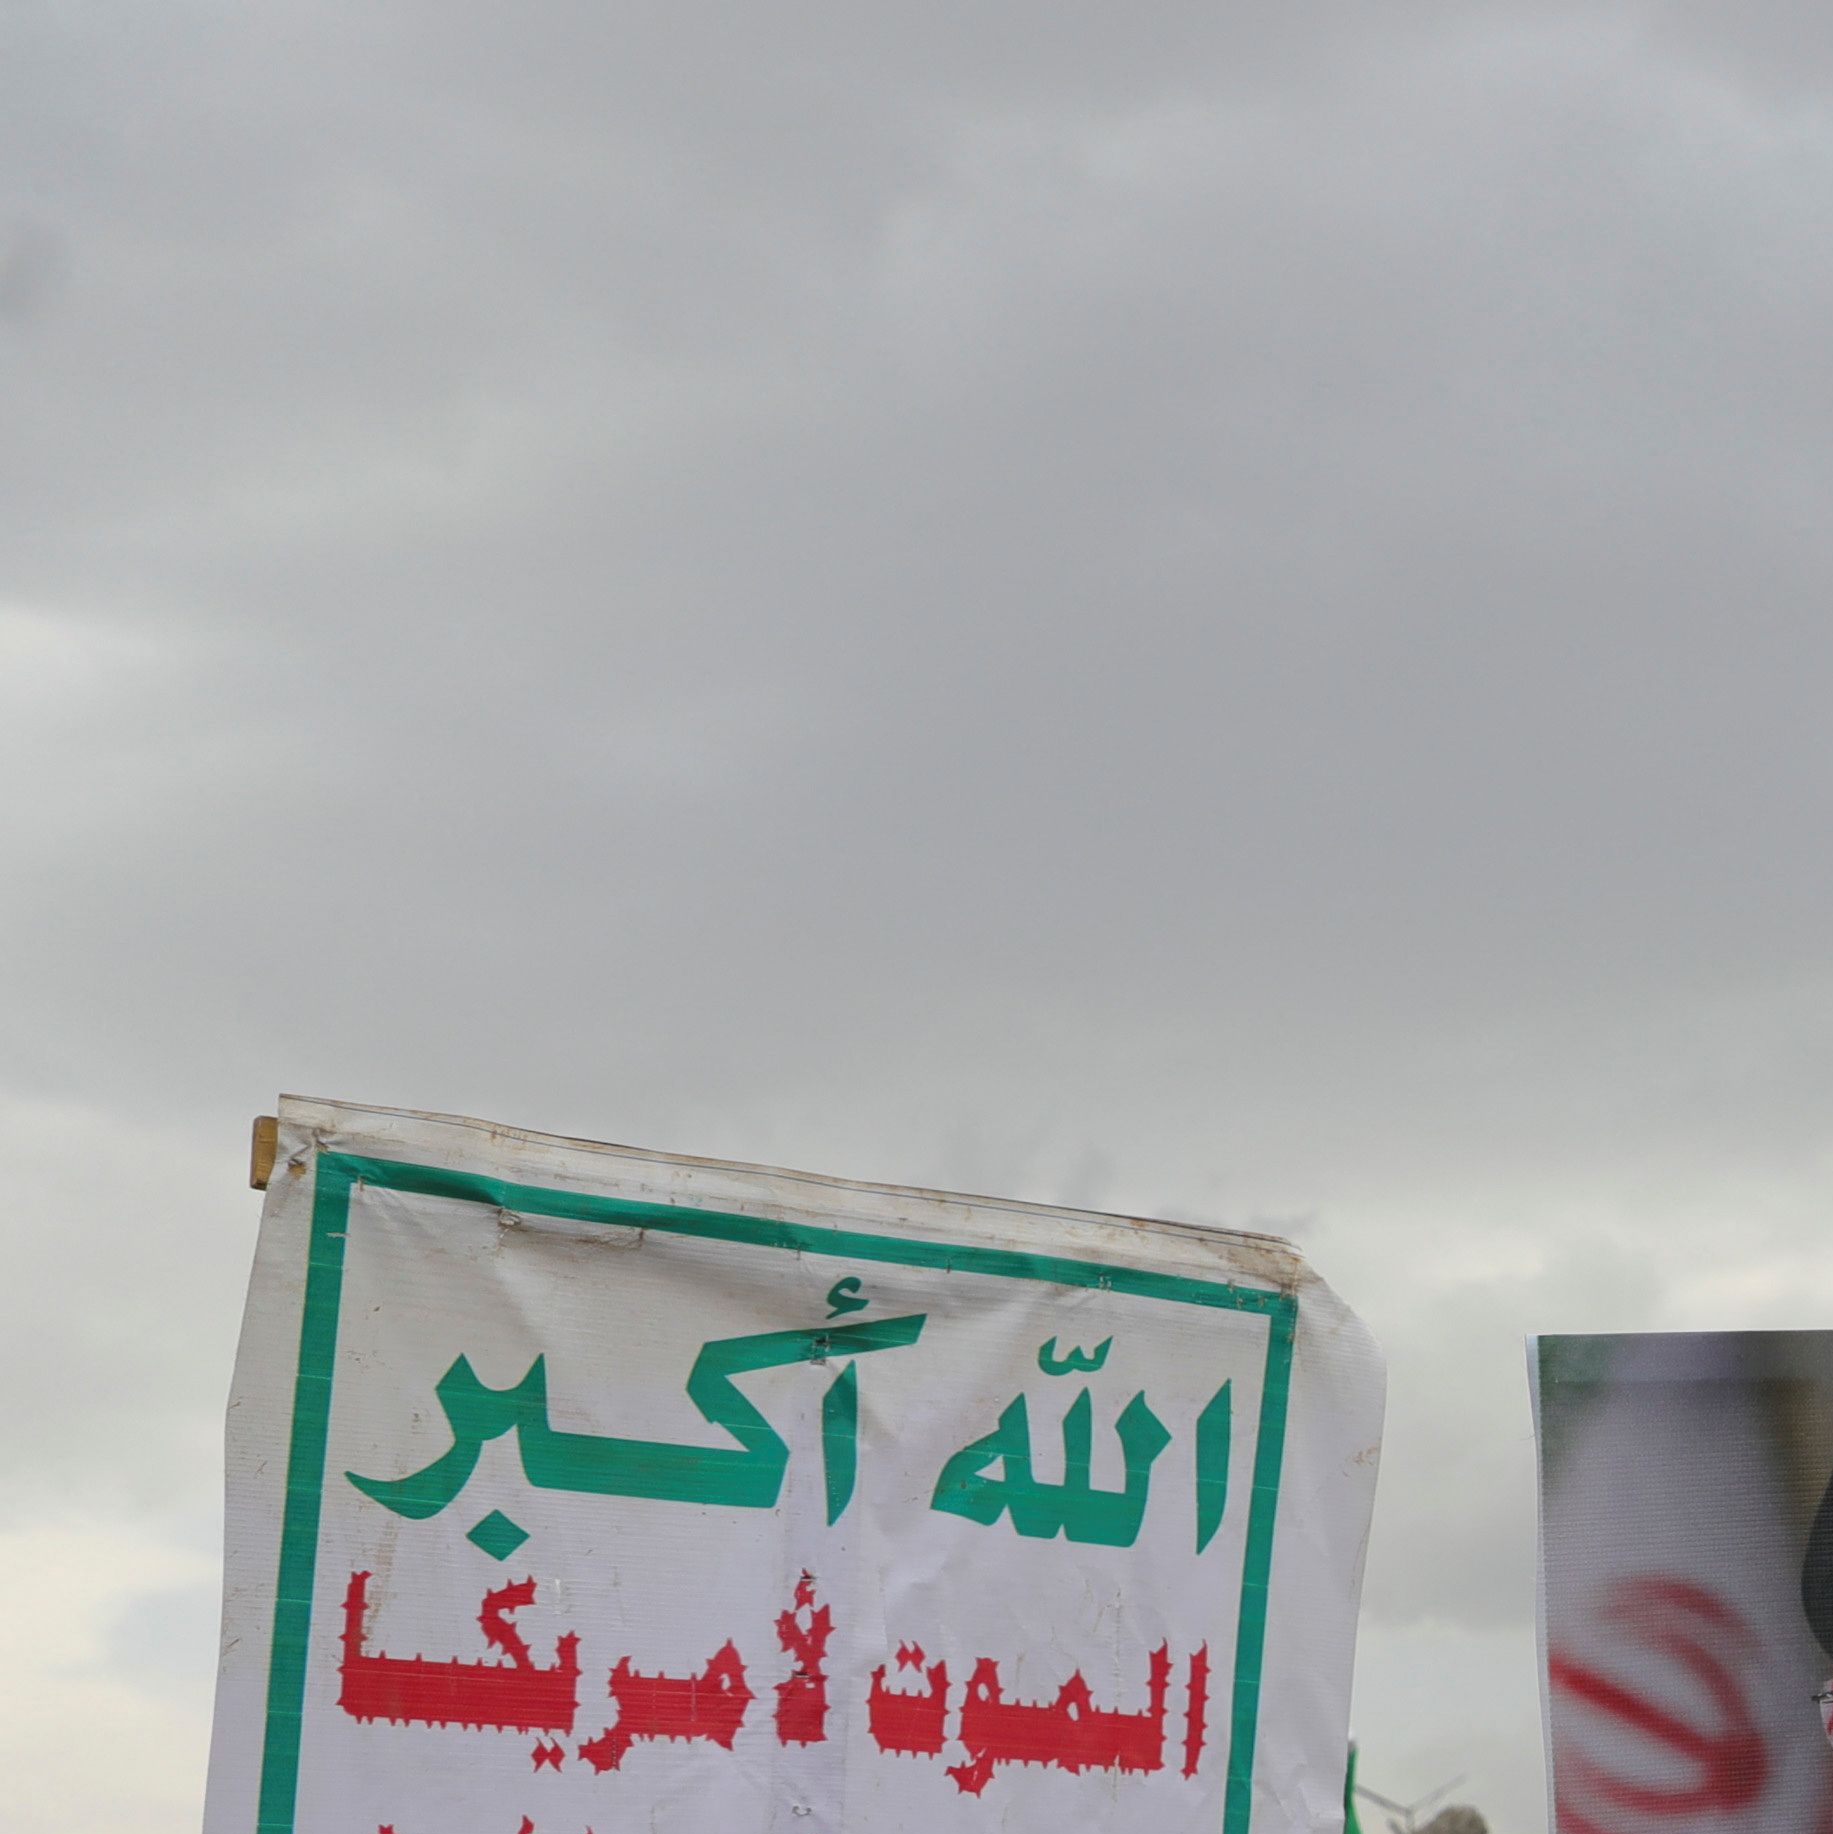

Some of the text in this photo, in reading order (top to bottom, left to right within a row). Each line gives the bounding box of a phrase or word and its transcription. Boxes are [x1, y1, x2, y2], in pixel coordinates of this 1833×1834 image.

[345, 1275, 928, 1561] أكبر
[337, 1569, 1210, 1796] الموت لأمريكا
